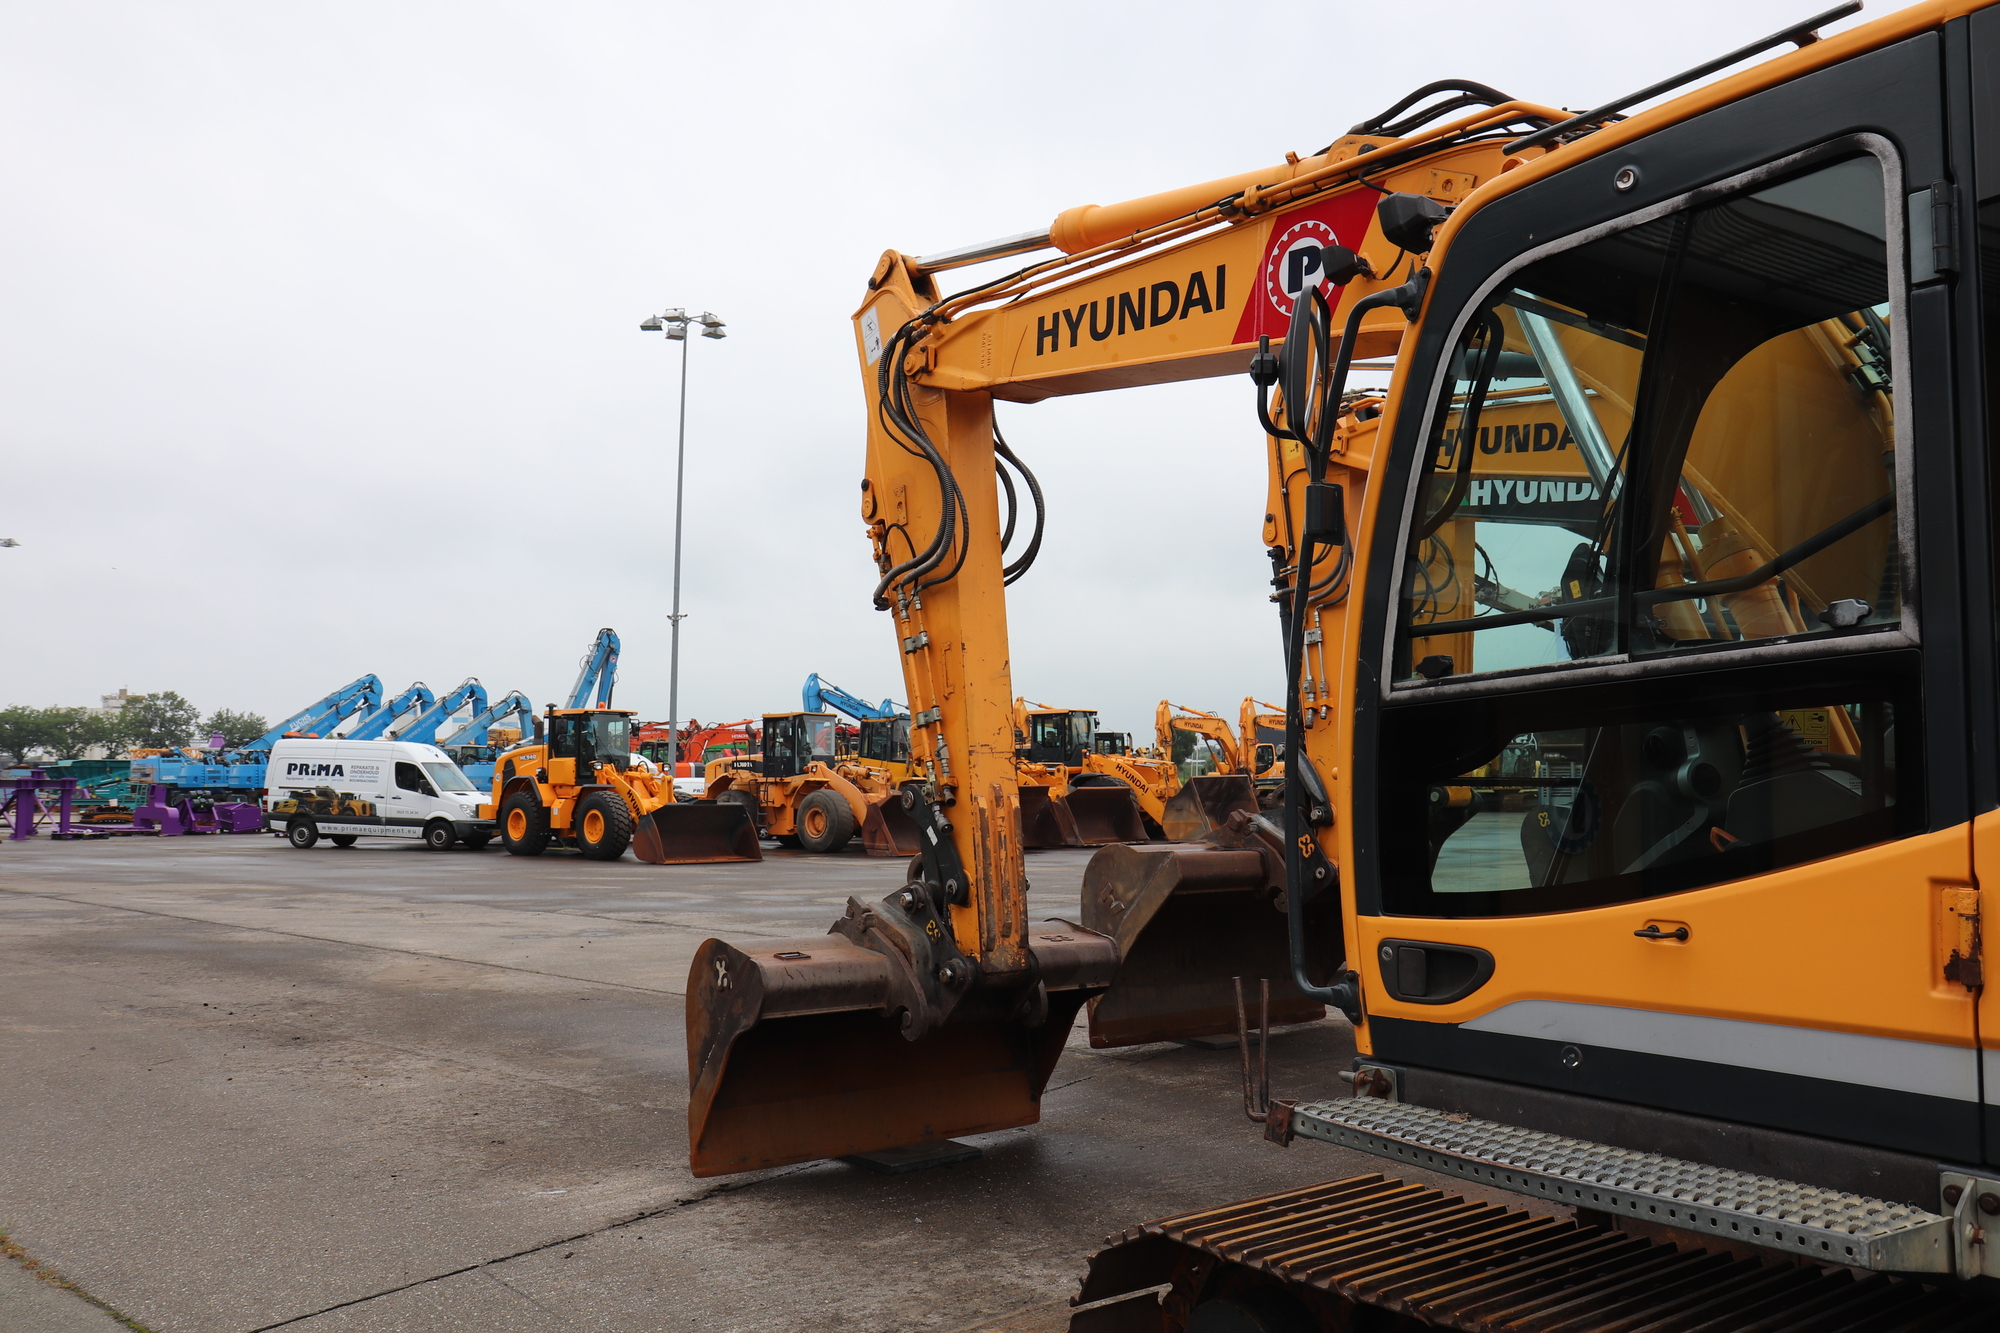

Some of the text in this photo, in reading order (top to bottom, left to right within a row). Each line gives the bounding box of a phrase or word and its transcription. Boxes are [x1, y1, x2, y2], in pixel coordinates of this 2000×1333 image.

[1036, 263, 1226, 357] HYUNDAI
[288, 713, 311, 730] FUCHS
[1184, 721, 1204, 730] HYUNDAI
[1115, 763, 1149, 794] HYUNDAI
[627, 789, 642, 819] HYUN
[321, 825, 416, 835] www.primaequipment.eu
